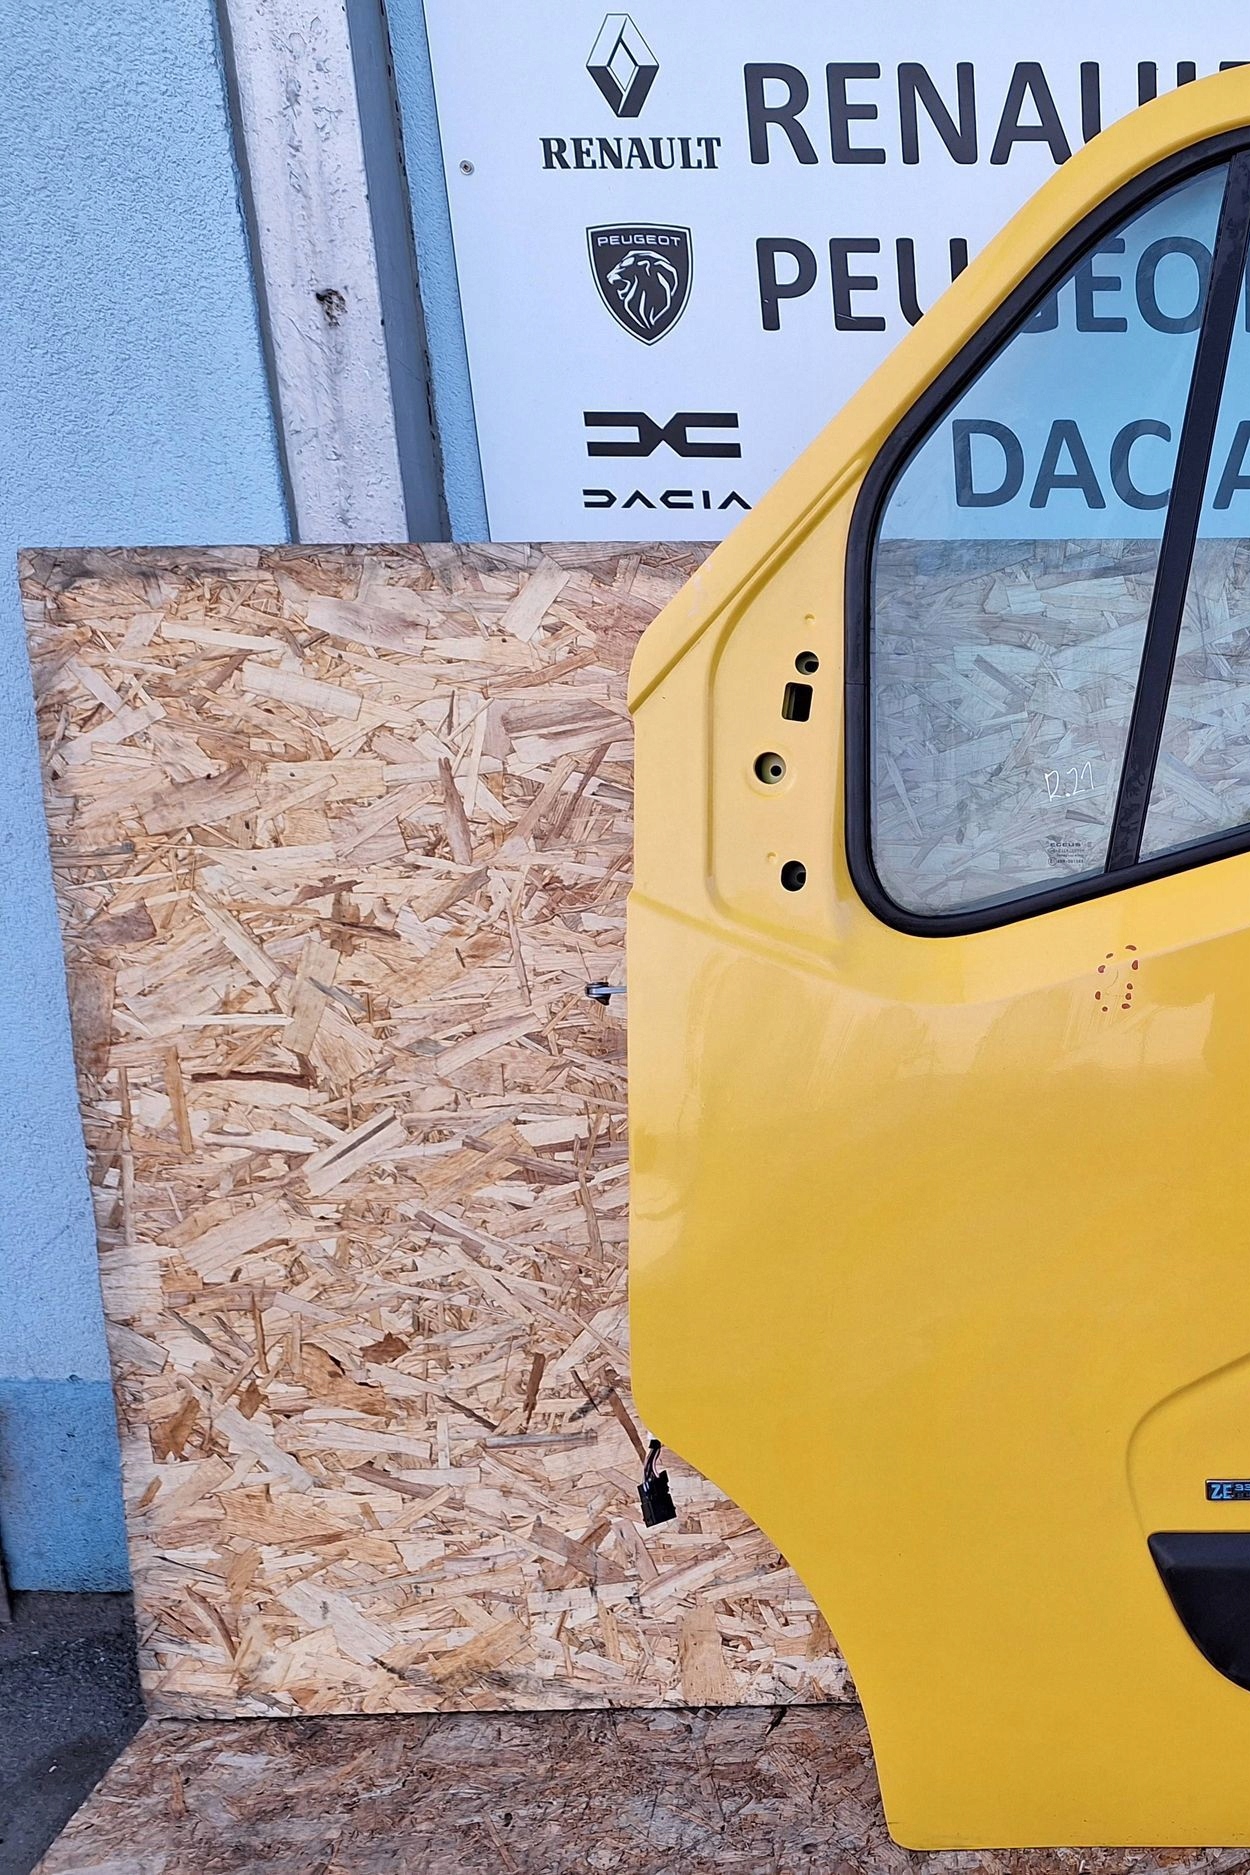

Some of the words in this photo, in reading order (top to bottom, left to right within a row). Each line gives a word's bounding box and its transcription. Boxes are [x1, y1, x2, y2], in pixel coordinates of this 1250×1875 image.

[541, 137, 722, 170] RENAULT
[597, 234, 681, 247] PEUGEOT
[583, 489, 752, 509] DACIA
[1211, 1483, 1233, 1500] ZE
